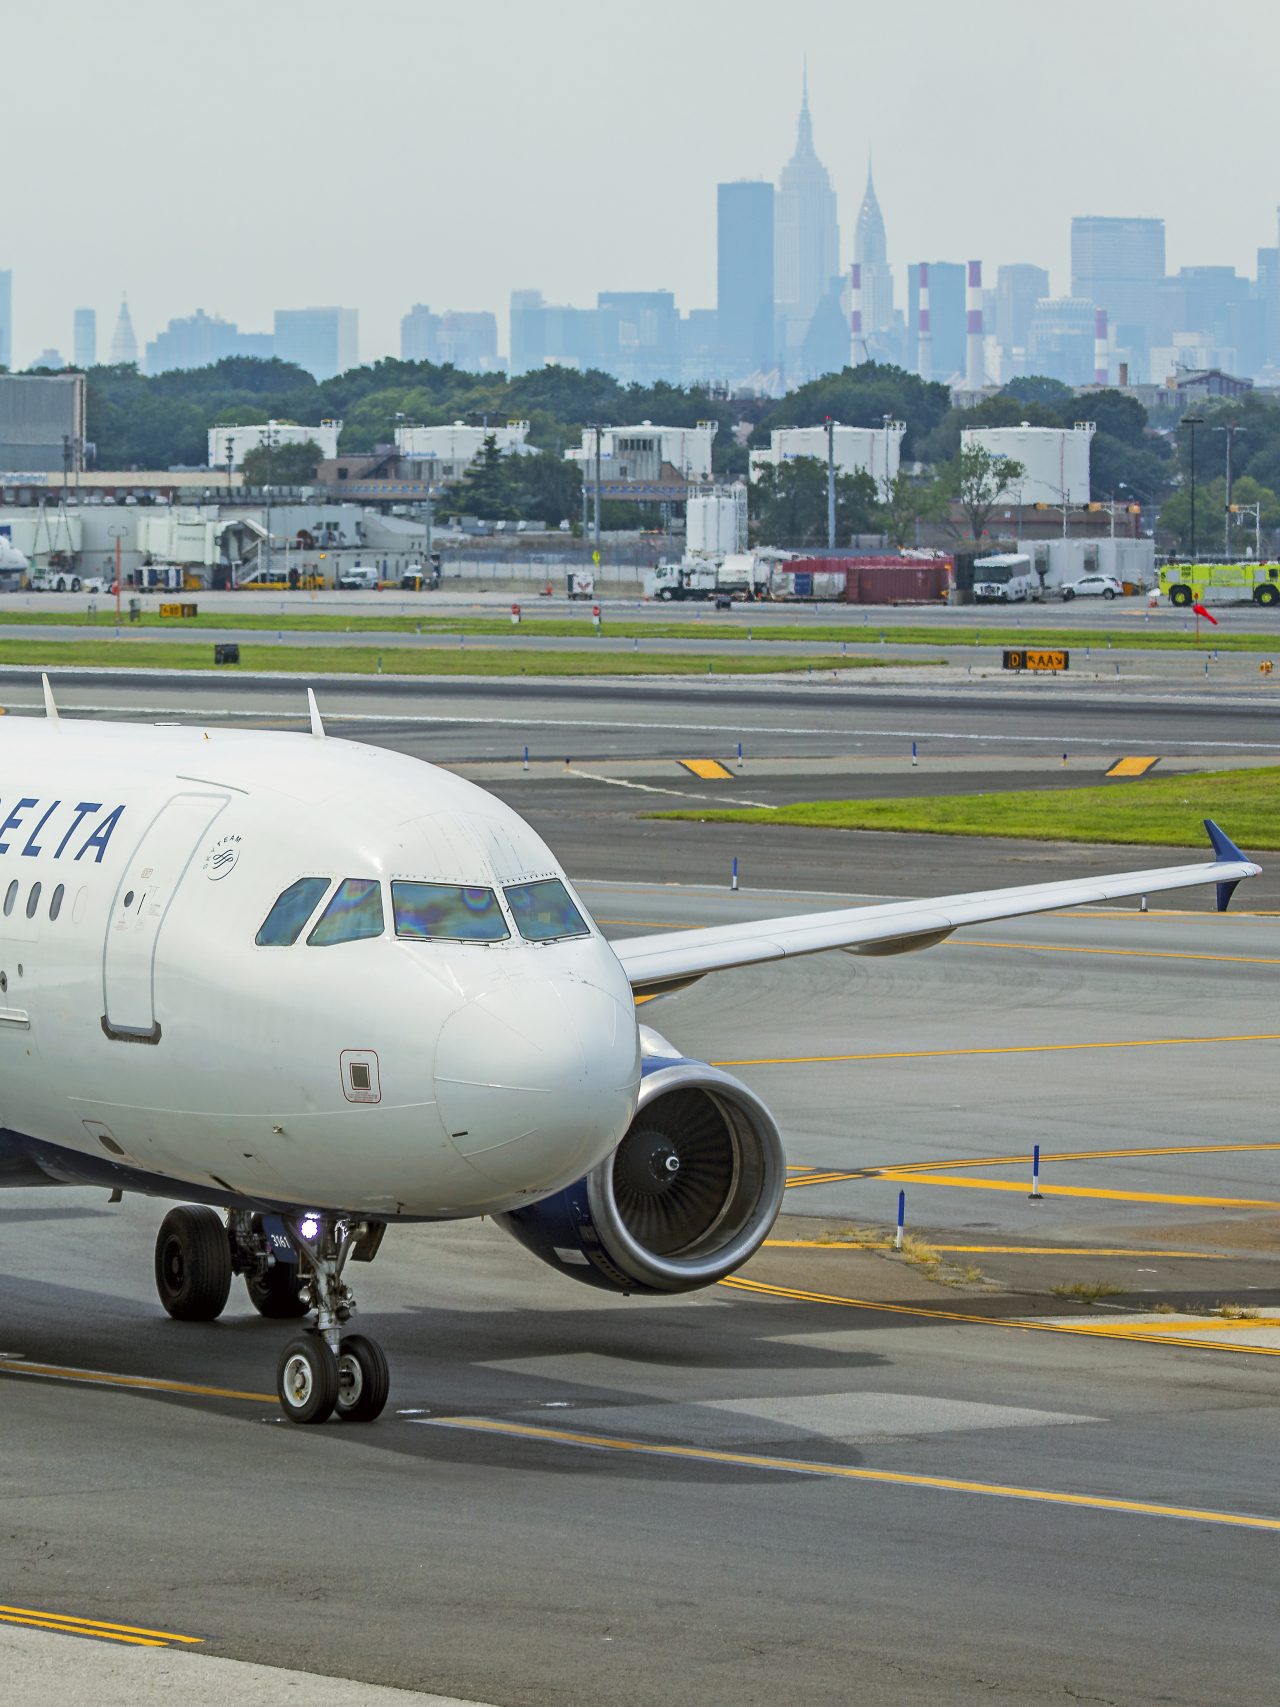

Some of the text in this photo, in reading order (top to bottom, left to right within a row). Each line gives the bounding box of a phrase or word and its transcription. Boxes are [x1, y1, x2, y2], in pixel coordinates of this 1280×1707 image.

[1011, 652, 1054, 667] D AA
[270, 1234, 291, 1249] 3161
